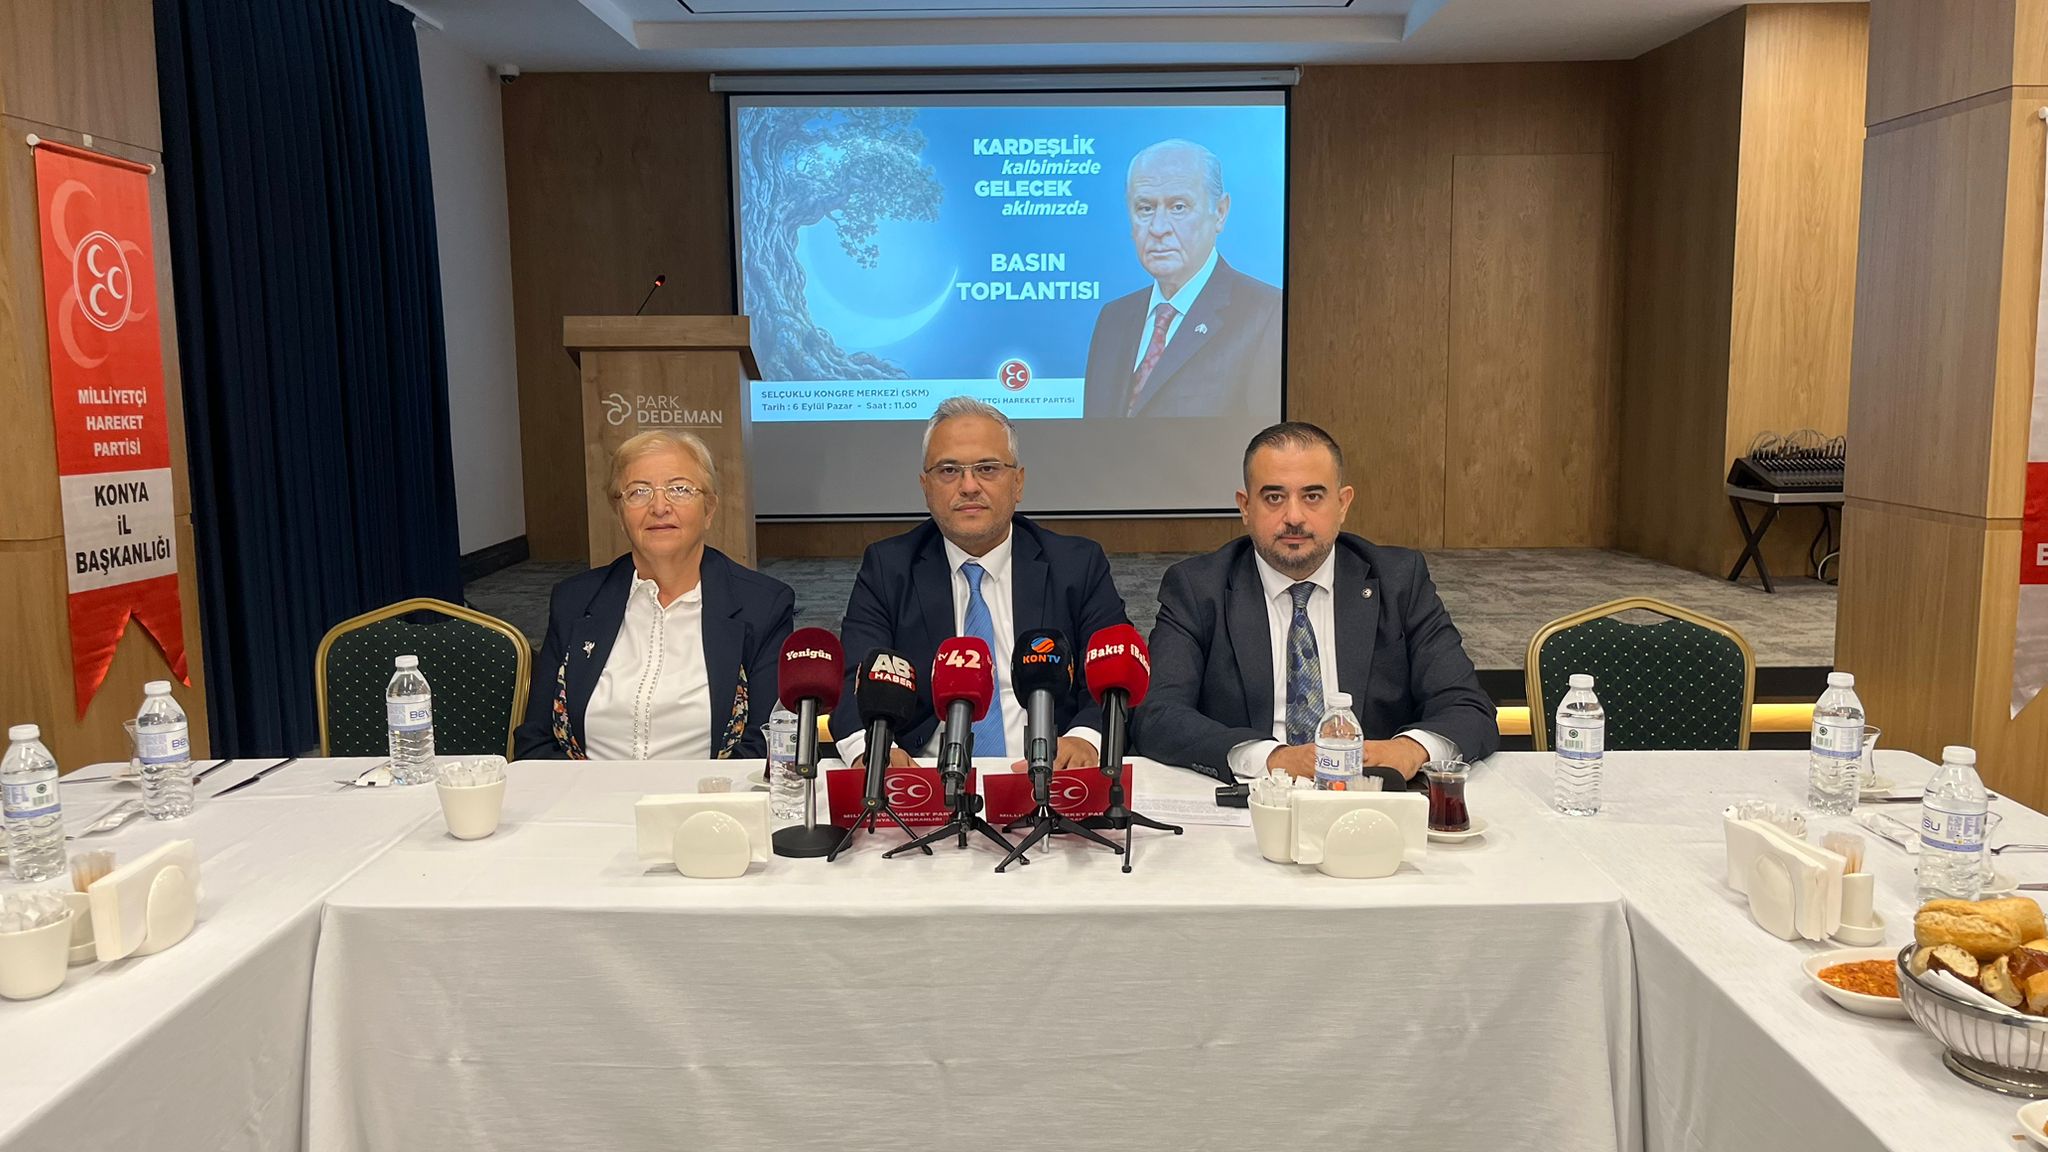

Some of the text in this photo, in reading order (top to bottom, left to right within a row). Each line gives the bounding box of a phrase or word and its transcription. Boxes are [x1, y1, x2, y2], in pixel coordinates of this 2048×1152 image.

[973, 134, 1096, 158] KARDEŞLİK
[1001, 159, 1102, 175] kalbimizde
[974, 180, 1073, 197] GELECEK
[1002, 200, 1089, 216] aklımızda
[991, 253, 1066, 272] BASIN
[956, 281, 1100, 301] TOPLANTISI
[77, 386, 148, 408] MİLLİYETÇİ
[761, 388, 930, 399] SELÇUKLU KONGRE MERKEZİ (SKM)
[1043, 396, 1075, 404] PARTİSİ
[636, 395, 680, 409] PARK
[762, 402, 786, 411] Tarih
[792, 403, 799, 411] 6
[801, 402, 825, 412] Eylül
[827, 402, 853, 410] Pazar
[866, 402, 887, 410] Saat
[894, 402, 917, 410] 11.00
[86, 415, 144, 431] HAREKET
[637, 409, 723, 424] DEDEMAN
[93, 437, 141, 457] PARTİSİ
[94, 482, 149, 507] KONYA
[75, 535, 171, 576] BAŞKANLIĞI
[785, 648, 833, 661] Yenigün
[874, 672, 913, 689] HABER
